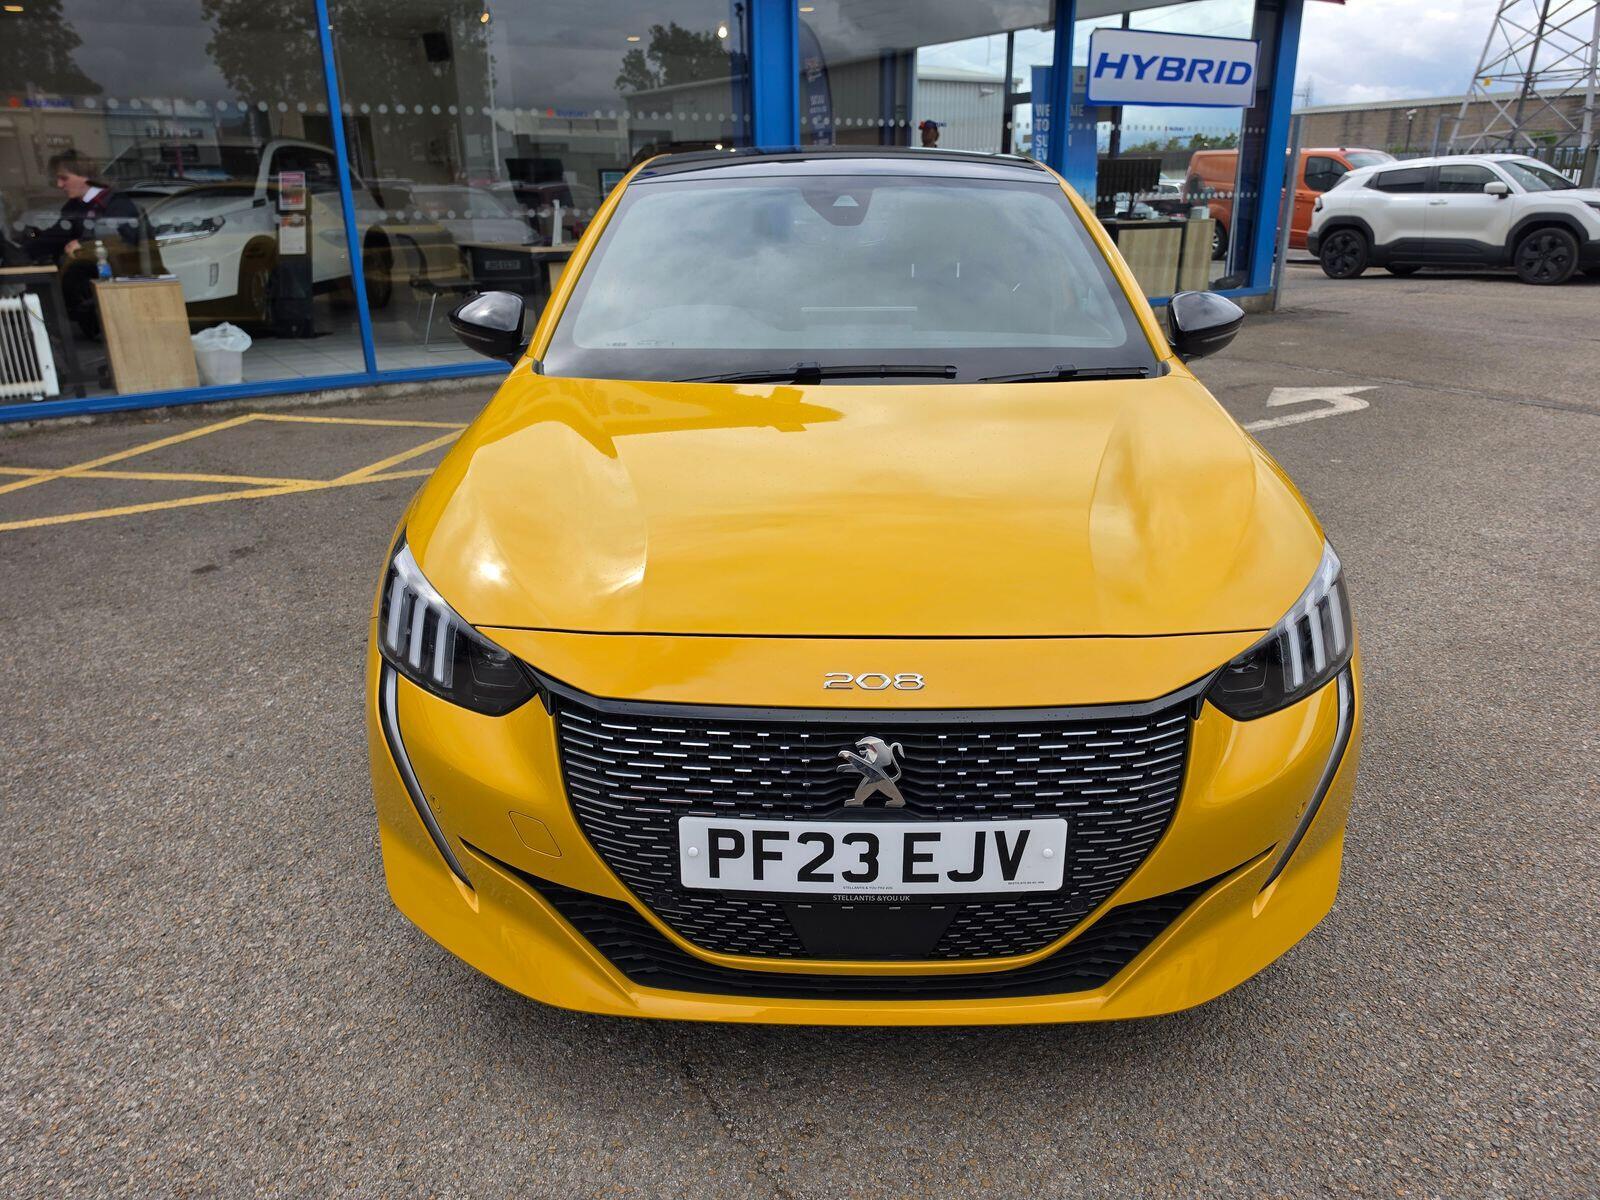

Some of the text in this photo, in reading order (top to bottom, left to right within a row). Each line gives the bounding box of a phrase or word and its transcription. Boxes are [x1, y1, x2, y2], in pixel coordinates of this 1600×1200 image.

[1094, 53, 1252, 85] HYBRID
[823, 672, 925, 690] 208
[708, 828, 1031, 883] PF23 EJV
